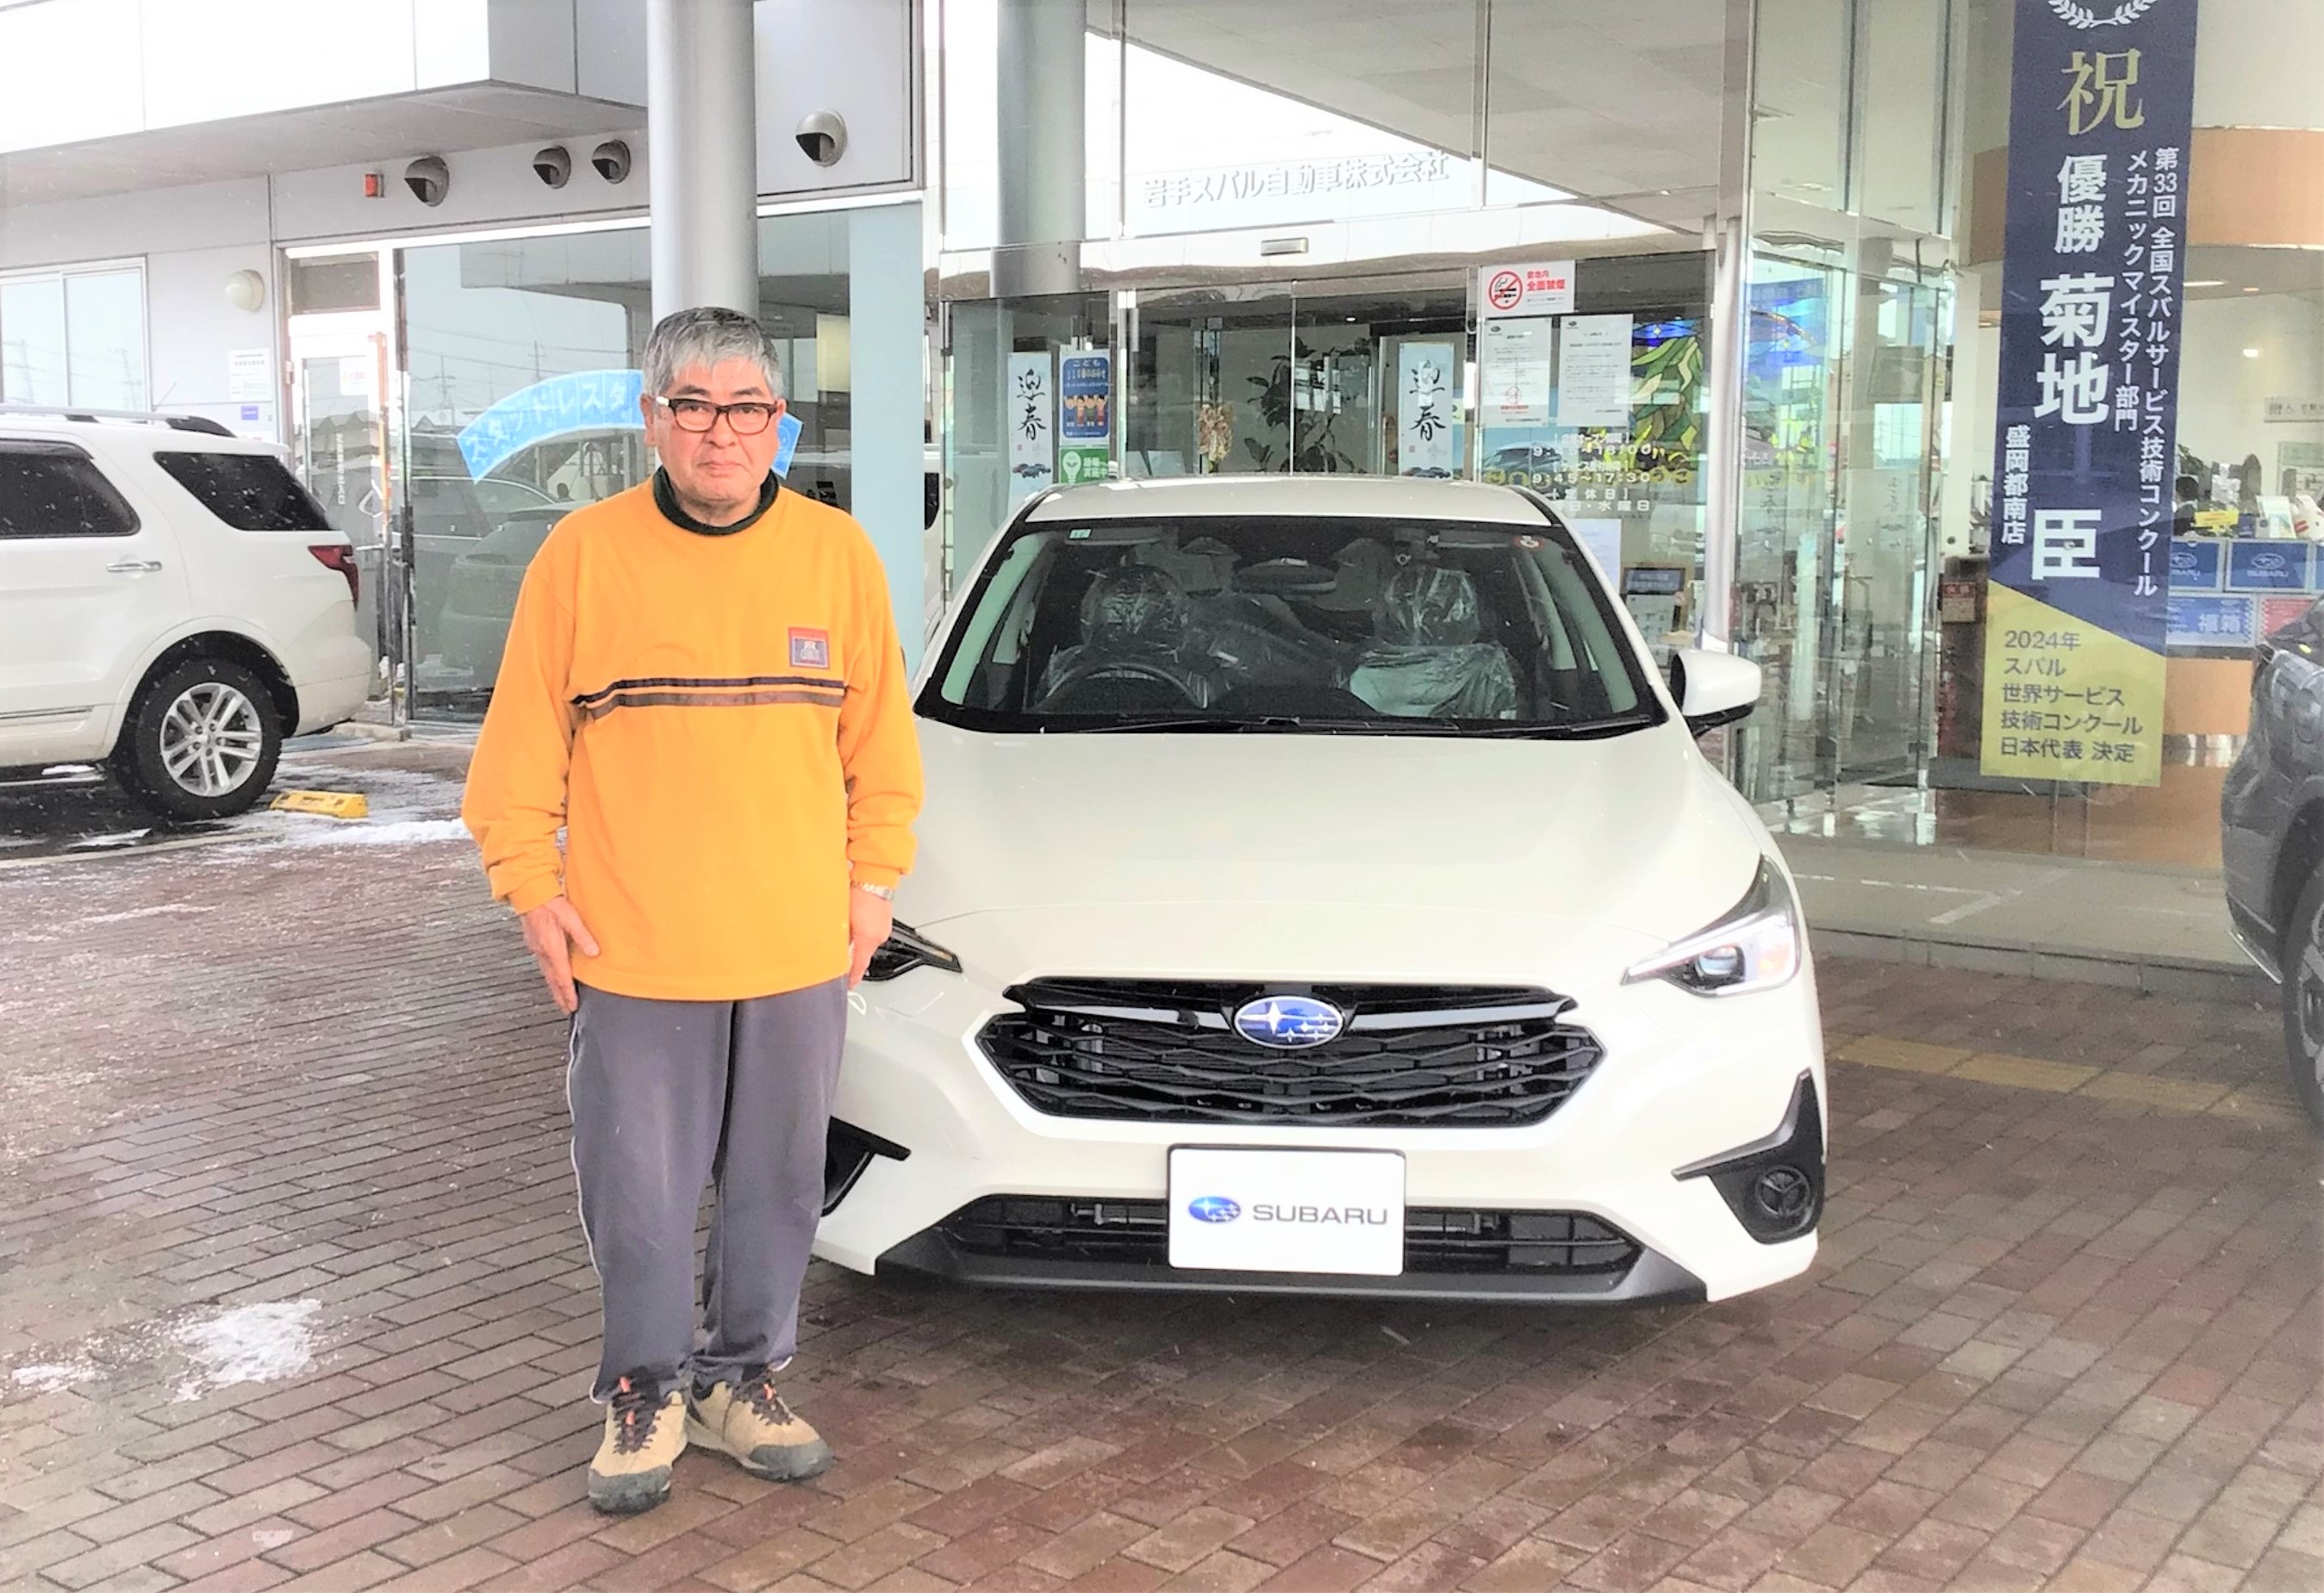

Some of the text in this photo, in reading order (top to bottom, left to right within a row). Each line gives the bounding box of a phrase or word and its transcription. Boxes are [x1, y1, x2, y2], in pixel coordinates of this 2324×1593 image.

[2057, 47, 2146, 136] 祝
[1143, 148, 1449, 208] 岩手スバル自動車株式会社
[2115, 150, 2148, 432] メカニックマイスター部門
[2031, 153, 2115, 581] 優勝 菊地 臣
[2134, 146, 2179, 598] 第33回 全国スバルサービス技術コンクール
[1017, 369, 1046, 440] 迎春
[1409, 360, 1447, 442] 迎春
[2001, 425, 2032, 544] 盛岡都南店
[2004, 629, 2081, 651] 2024年
[2005, 657, 2066, 677] スバル
[2000, 711, 2144, 736] 技術コンクール
[2002, 681, 2126, 707] 世界サービス
[2000, 736, 2136, 764] 日本代表 決定
[1253, 1204, 1388, 1226] SUBARU
